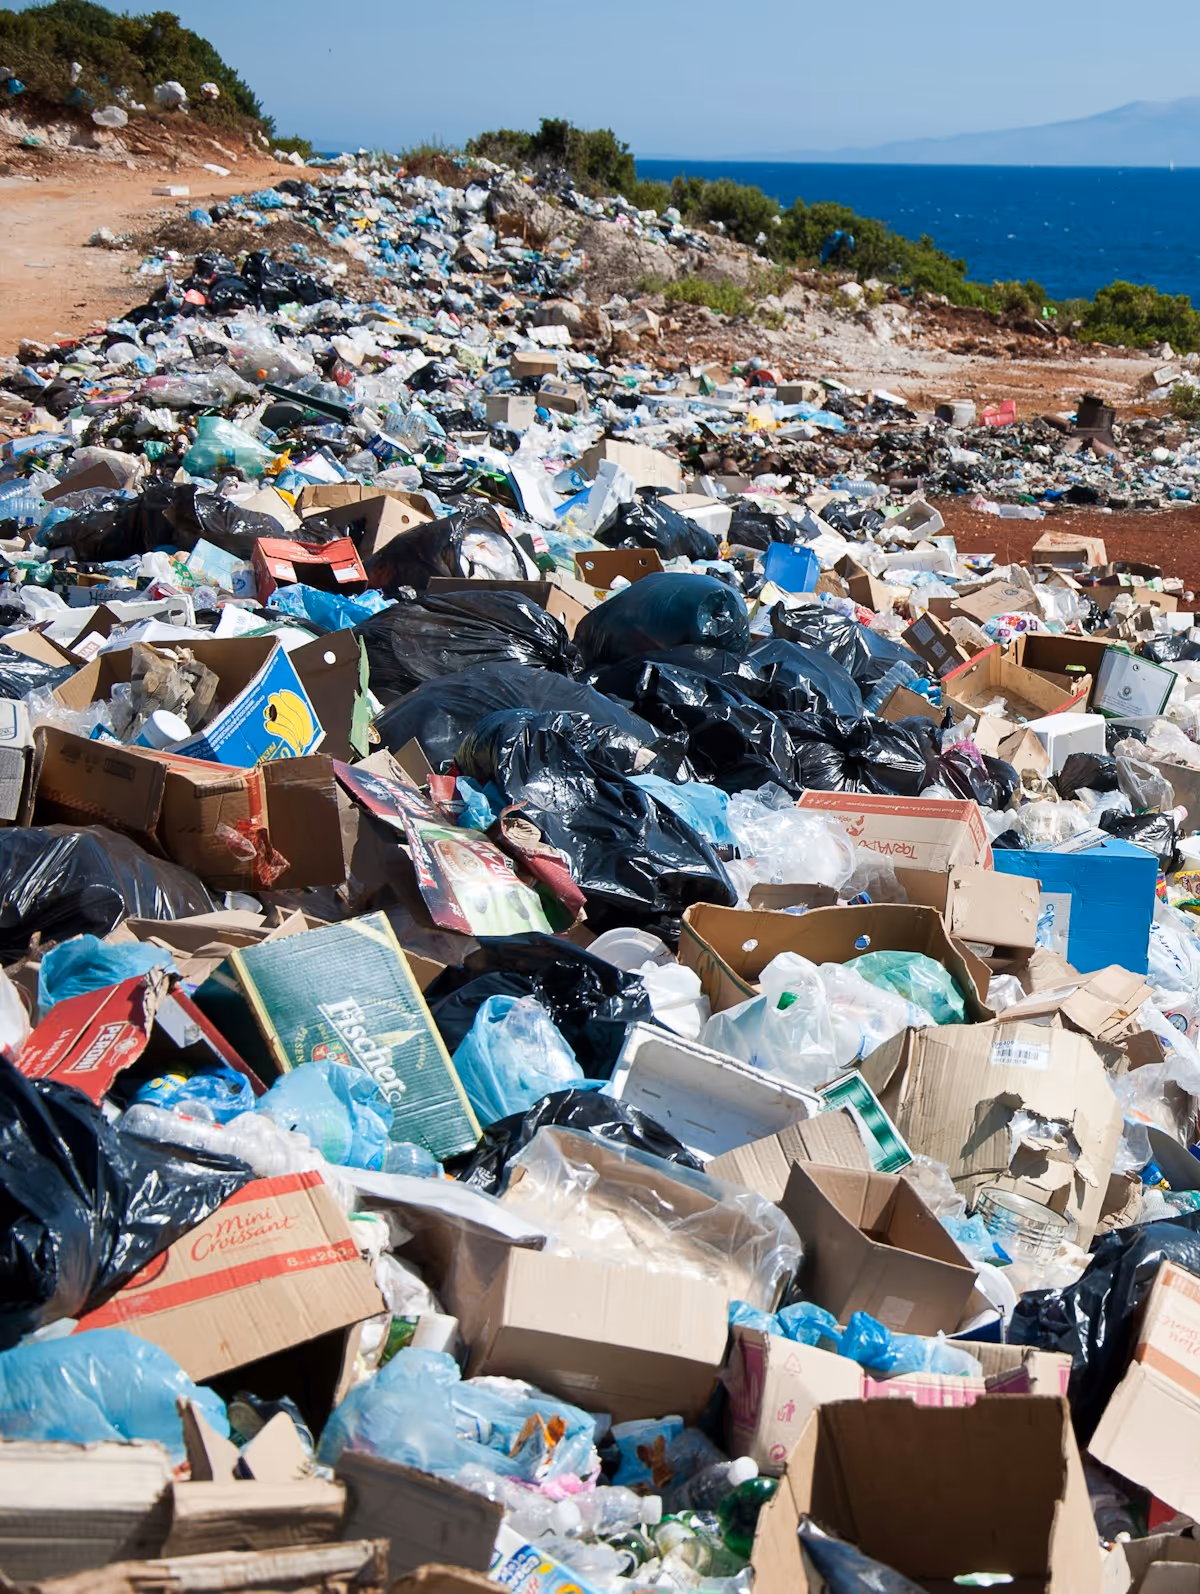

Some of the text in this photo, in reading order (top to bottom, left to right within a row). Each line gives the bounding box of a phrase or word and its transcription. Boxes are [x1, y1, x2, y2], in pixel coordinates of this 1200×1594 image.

[75, 1025, 123, 1071] PERONI
[295, 1026, 308, 1066] PILSEN
[322, 996, 407, 1095] Fischer
[191, 1215, 299, 1262] Croissant
[215, 1207, 273, 1239] Mini
